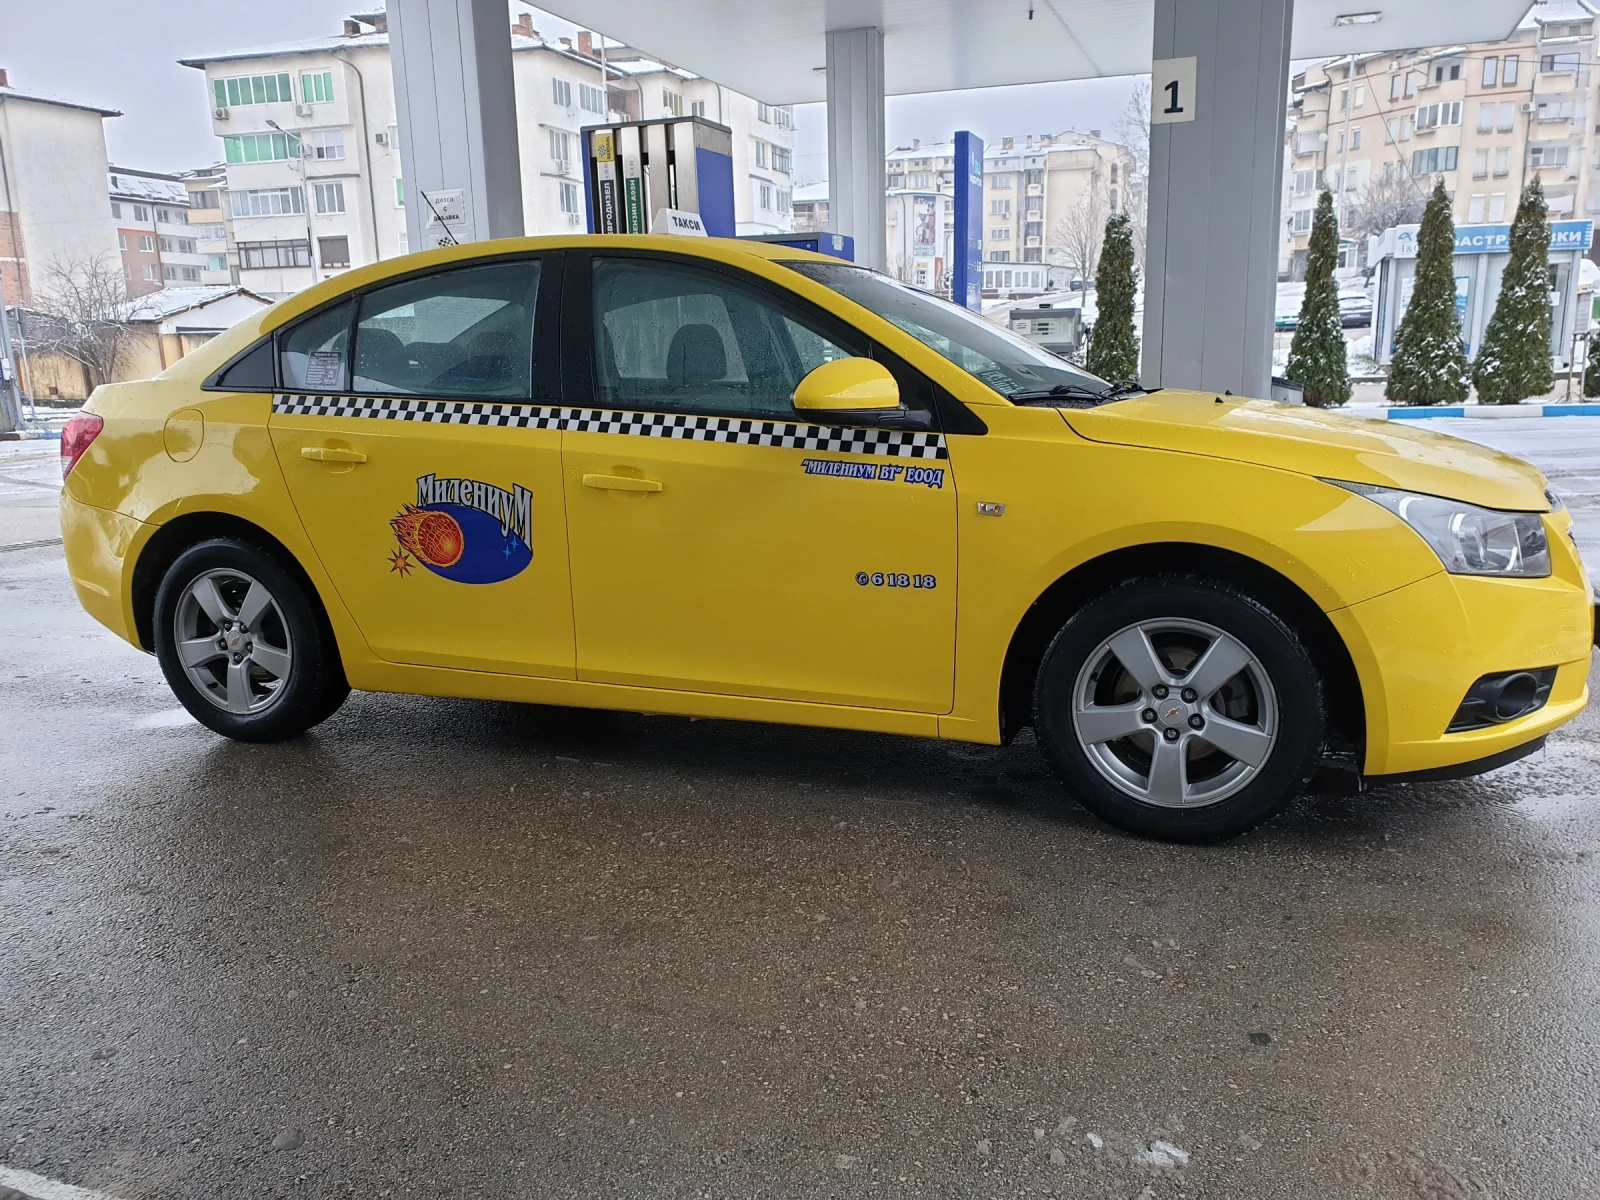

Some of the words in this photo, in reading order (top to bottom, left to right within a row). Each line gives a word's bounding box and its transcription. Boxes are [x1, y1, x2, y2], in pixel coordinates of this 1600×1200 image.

[1164, 80, 1184, 114] 1
[435, 197, 454, 205] ДИЗЕЛ
[672, 216, 701, 231] ТАКСИ
[801, 459, 878, 479] "МИЛЕНИУМ
[904, 467, 944, 489] ЕООД
[871, 572, 884, 586] 6
[887, 573, 910, 587] 18
[913, 575, 936, 589] 18
